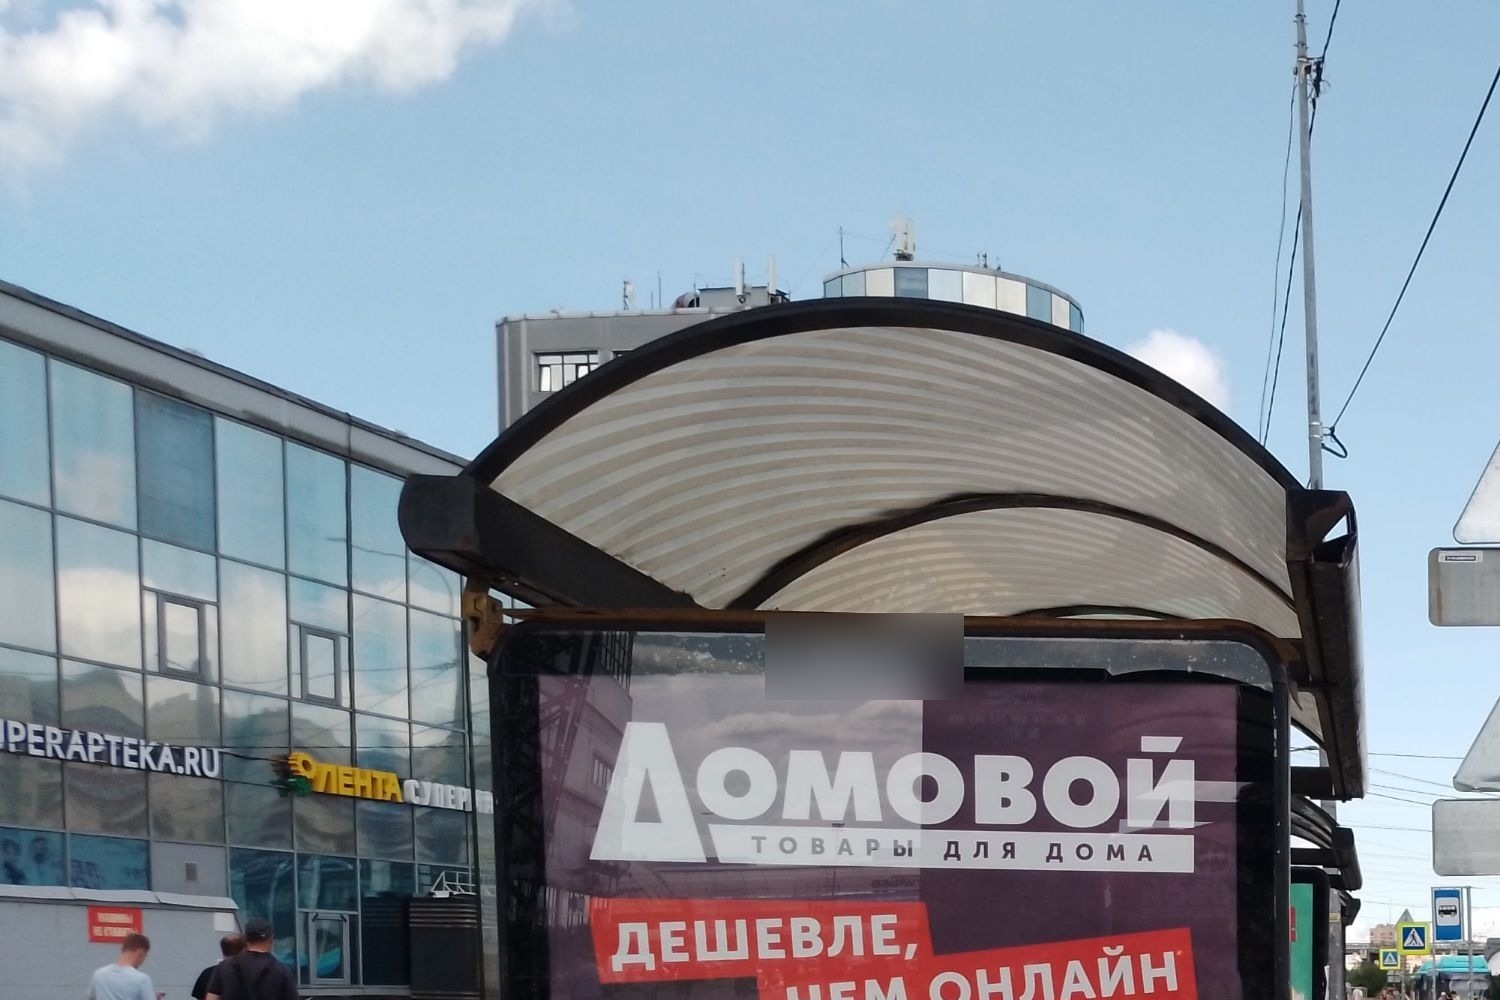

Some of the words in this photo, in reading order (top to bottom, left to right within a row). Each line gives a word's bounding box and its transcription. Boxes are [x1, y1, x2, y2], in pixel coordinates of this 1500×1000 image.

[0, 718, 220, 778] PERAPTEKA.RU
[314, 764, 404, 803] ЛЕНТА
[751, 834, 914, 859] ТОВАРЫ
[943, 841, 1017, 862] ДЛЯ
[1045, 842, 1154, 864] ДОМА
[611, 914, 919, 972] ДЕШЕВЛЕ,
